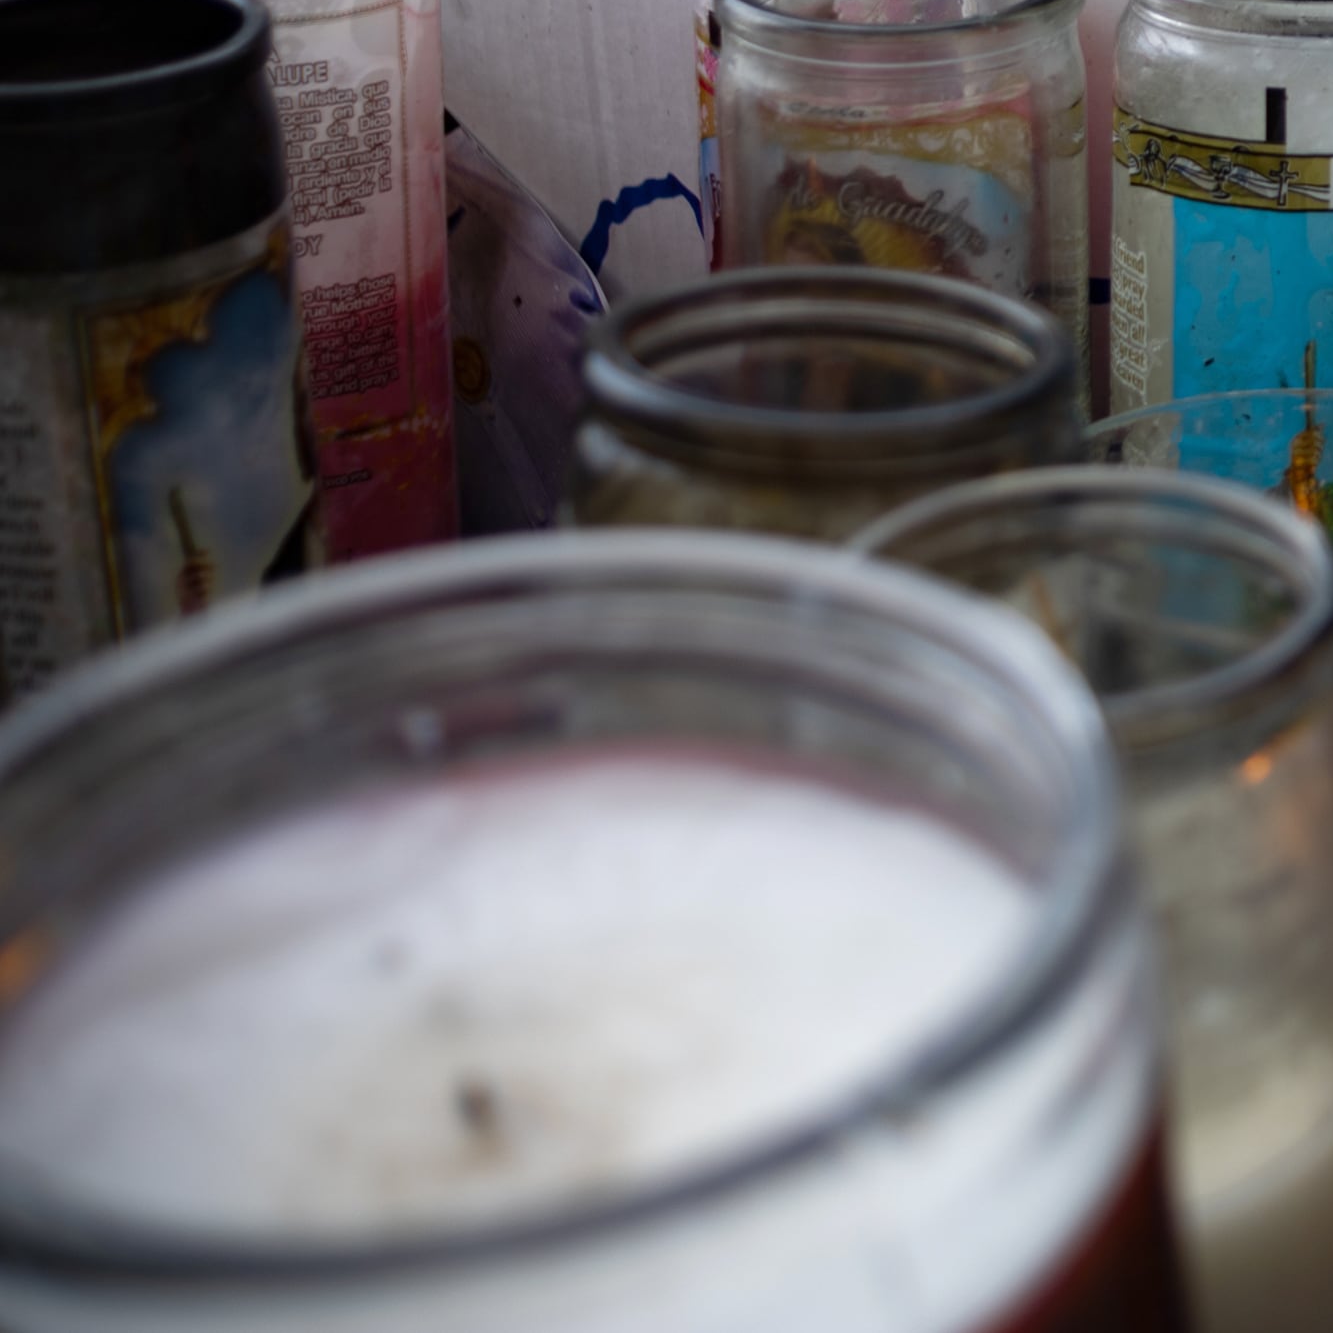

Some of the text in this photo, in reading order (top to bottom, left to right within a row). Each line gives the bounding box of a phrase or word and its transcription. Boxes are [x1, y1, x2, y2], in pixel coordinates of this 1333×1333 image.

[362, 80, 389, 102] que
[332, 104, 354, 120] en
[364, 96, 390, 113] sus
[327, 121, 348, 137] de
[358, 113, 391, 132] Dios
[309, 136, 358, 161] gracia
[364, 129, 391, 150] que
[349, 145, 391, 167] medio
[378, 176, 392, 192] la
[316, 283, 356, 303] helps
[358, 273, 396, 293] those
[331, 296, 379, 316] Mother
[382, 288, 397, 305] of
[367, 305, 397, 326] your
[348, 331, 361, 344] to
[330, 378, 357, 396] and
